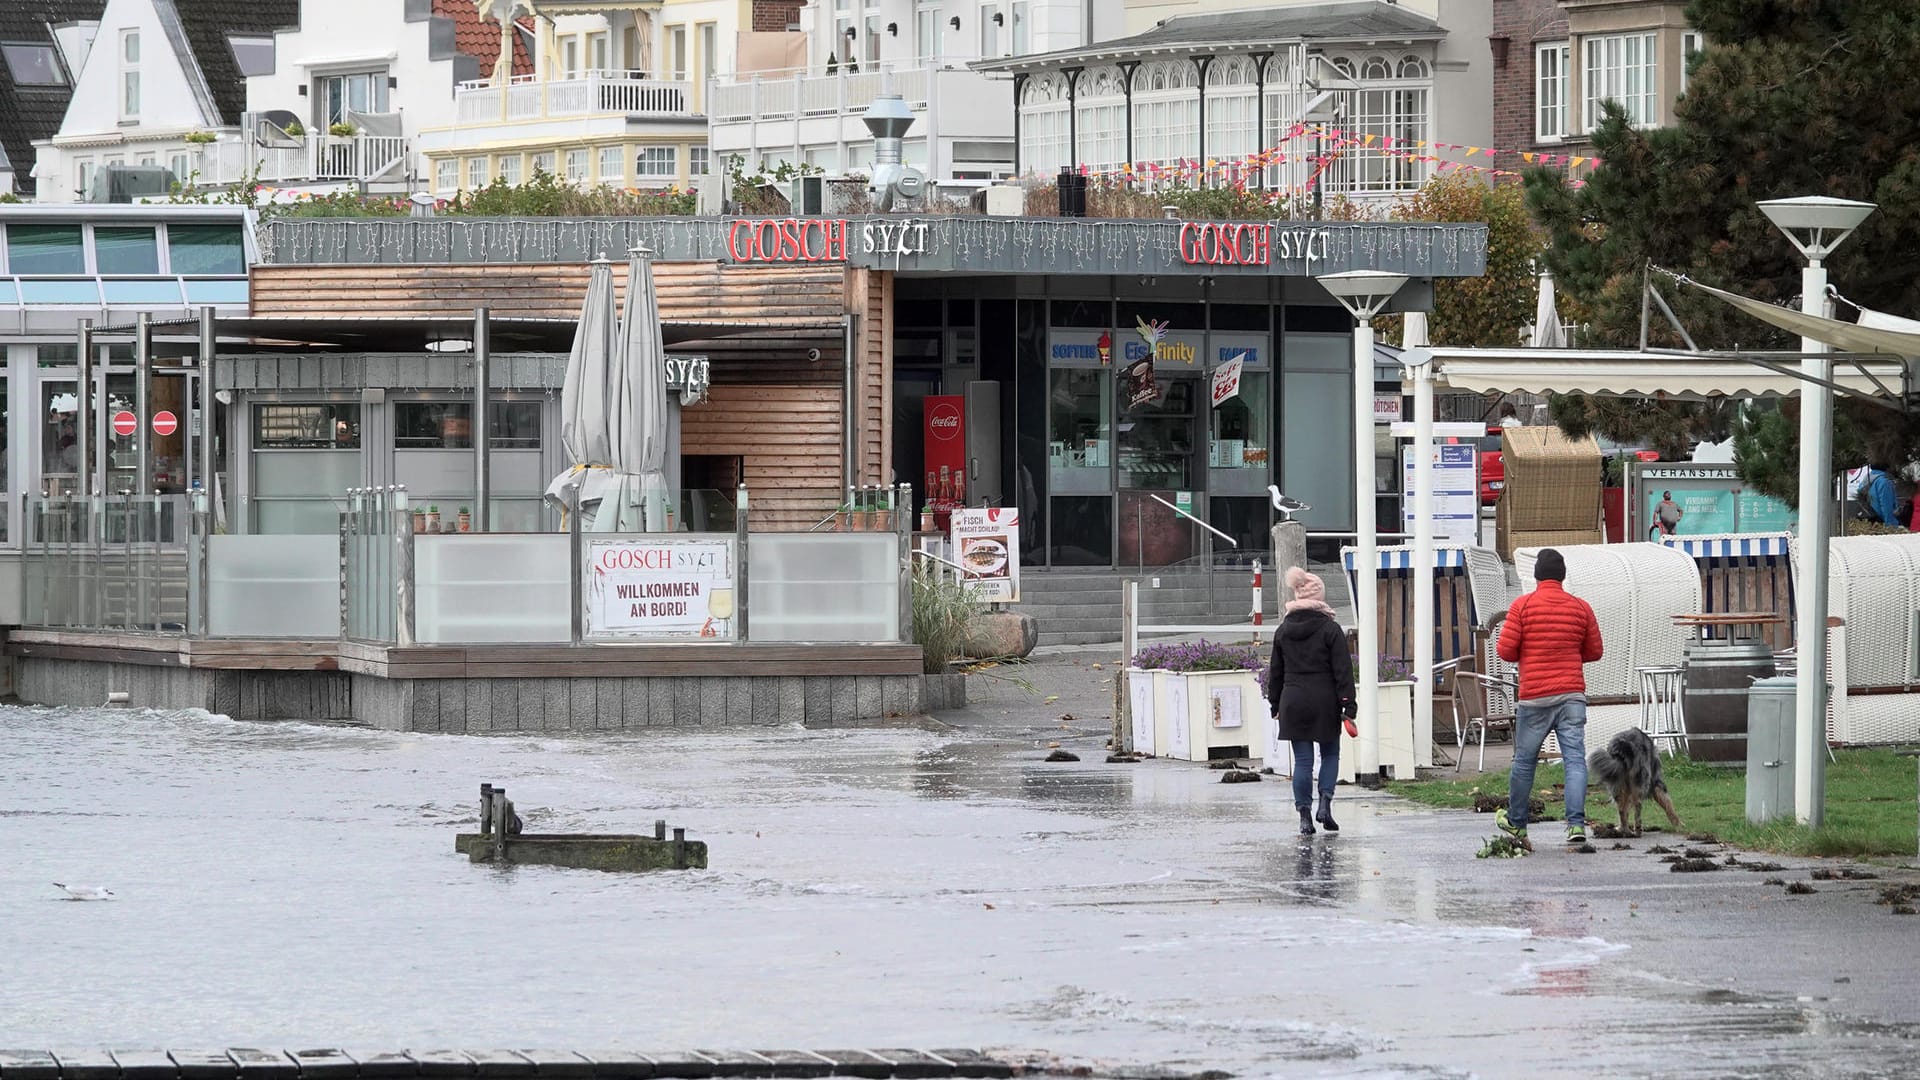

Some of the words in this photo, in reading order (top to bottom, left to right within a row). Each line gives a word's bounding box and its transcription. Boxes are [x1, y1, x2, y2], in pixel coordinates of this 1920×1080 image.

[729, 219, 848, 262] GOSCH
[863, 219, 928, 271] SYLT
[1180, 222, 1271, 265] GOSCH
[1281, 228, 1330, 277] SYLT
[666, 358, 710, 398] SYLT
[1131, 388, 1153, 402] Kaffee
[1374, 399, 1399, 413] ÖTCHEN
[931, 416, 959, 428] Coca-Cola
[1650, 469, 1733, 478] VERANSTAL
[963, 517, 984, 525] FISCH
[603, 549, 672, 570] GOSCH
[678, 552, 717, 574] SYLT
[617, 582, 700, 599] WILLKOMMEN
[630, 603, 647, 617] AN
[651, 601, 688, 617] BORD!
